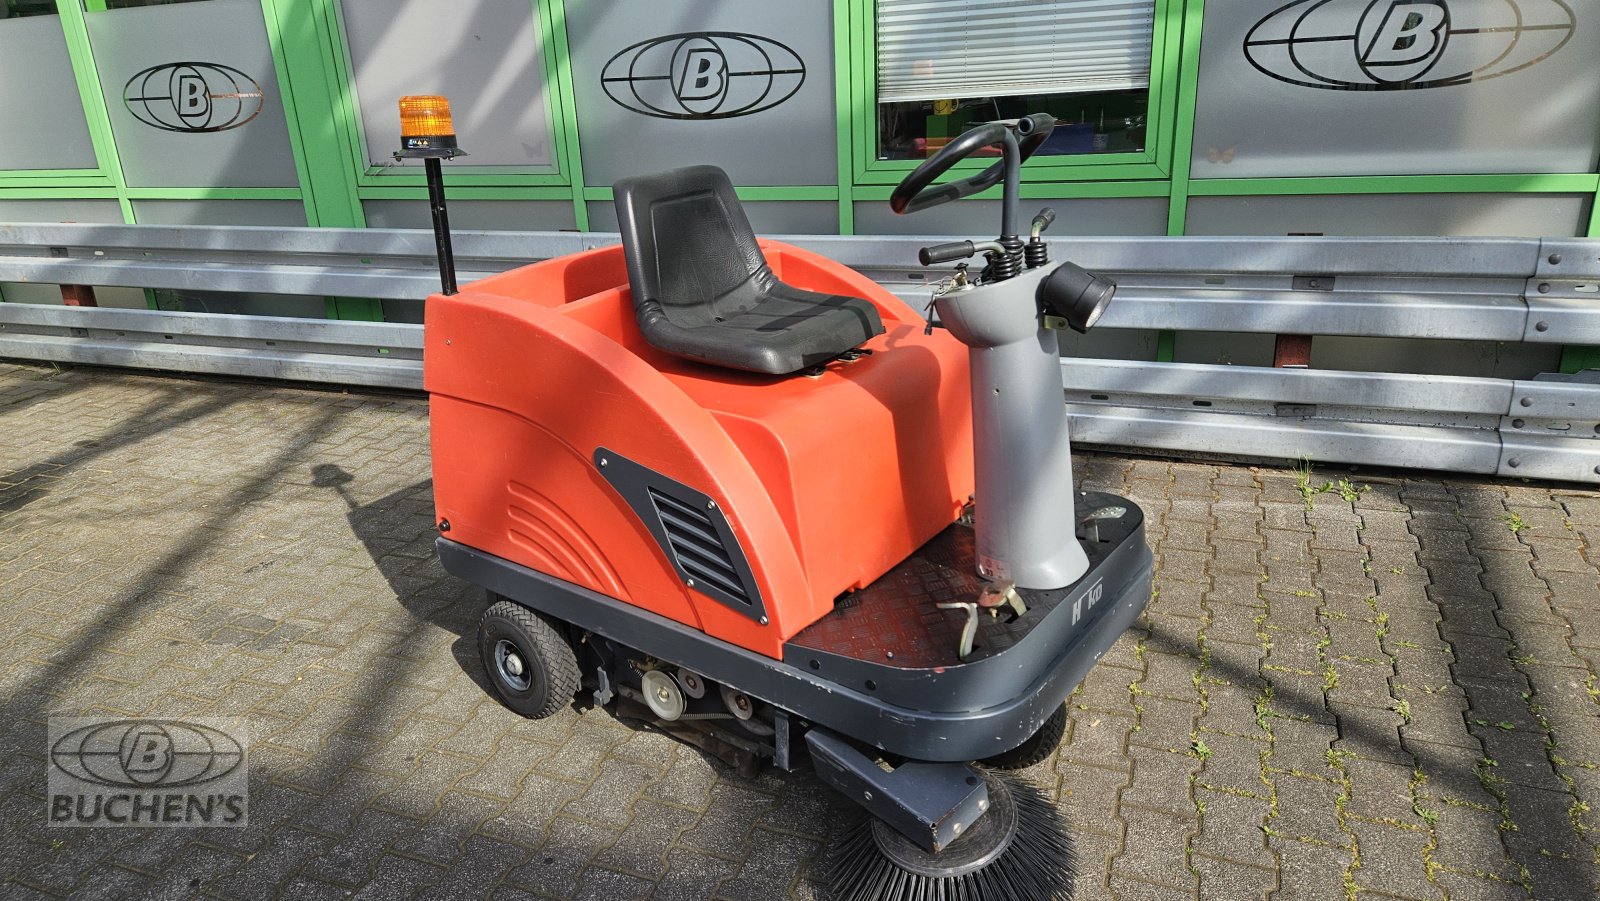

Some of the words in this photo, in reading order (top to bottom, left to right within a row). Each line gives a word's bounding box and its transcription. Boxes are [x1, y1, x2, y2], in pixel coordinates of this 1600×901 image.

[1361, 0, 1446, 66] B
[179, 75, 209, 117] B
[678, 48, 725, 100] B
